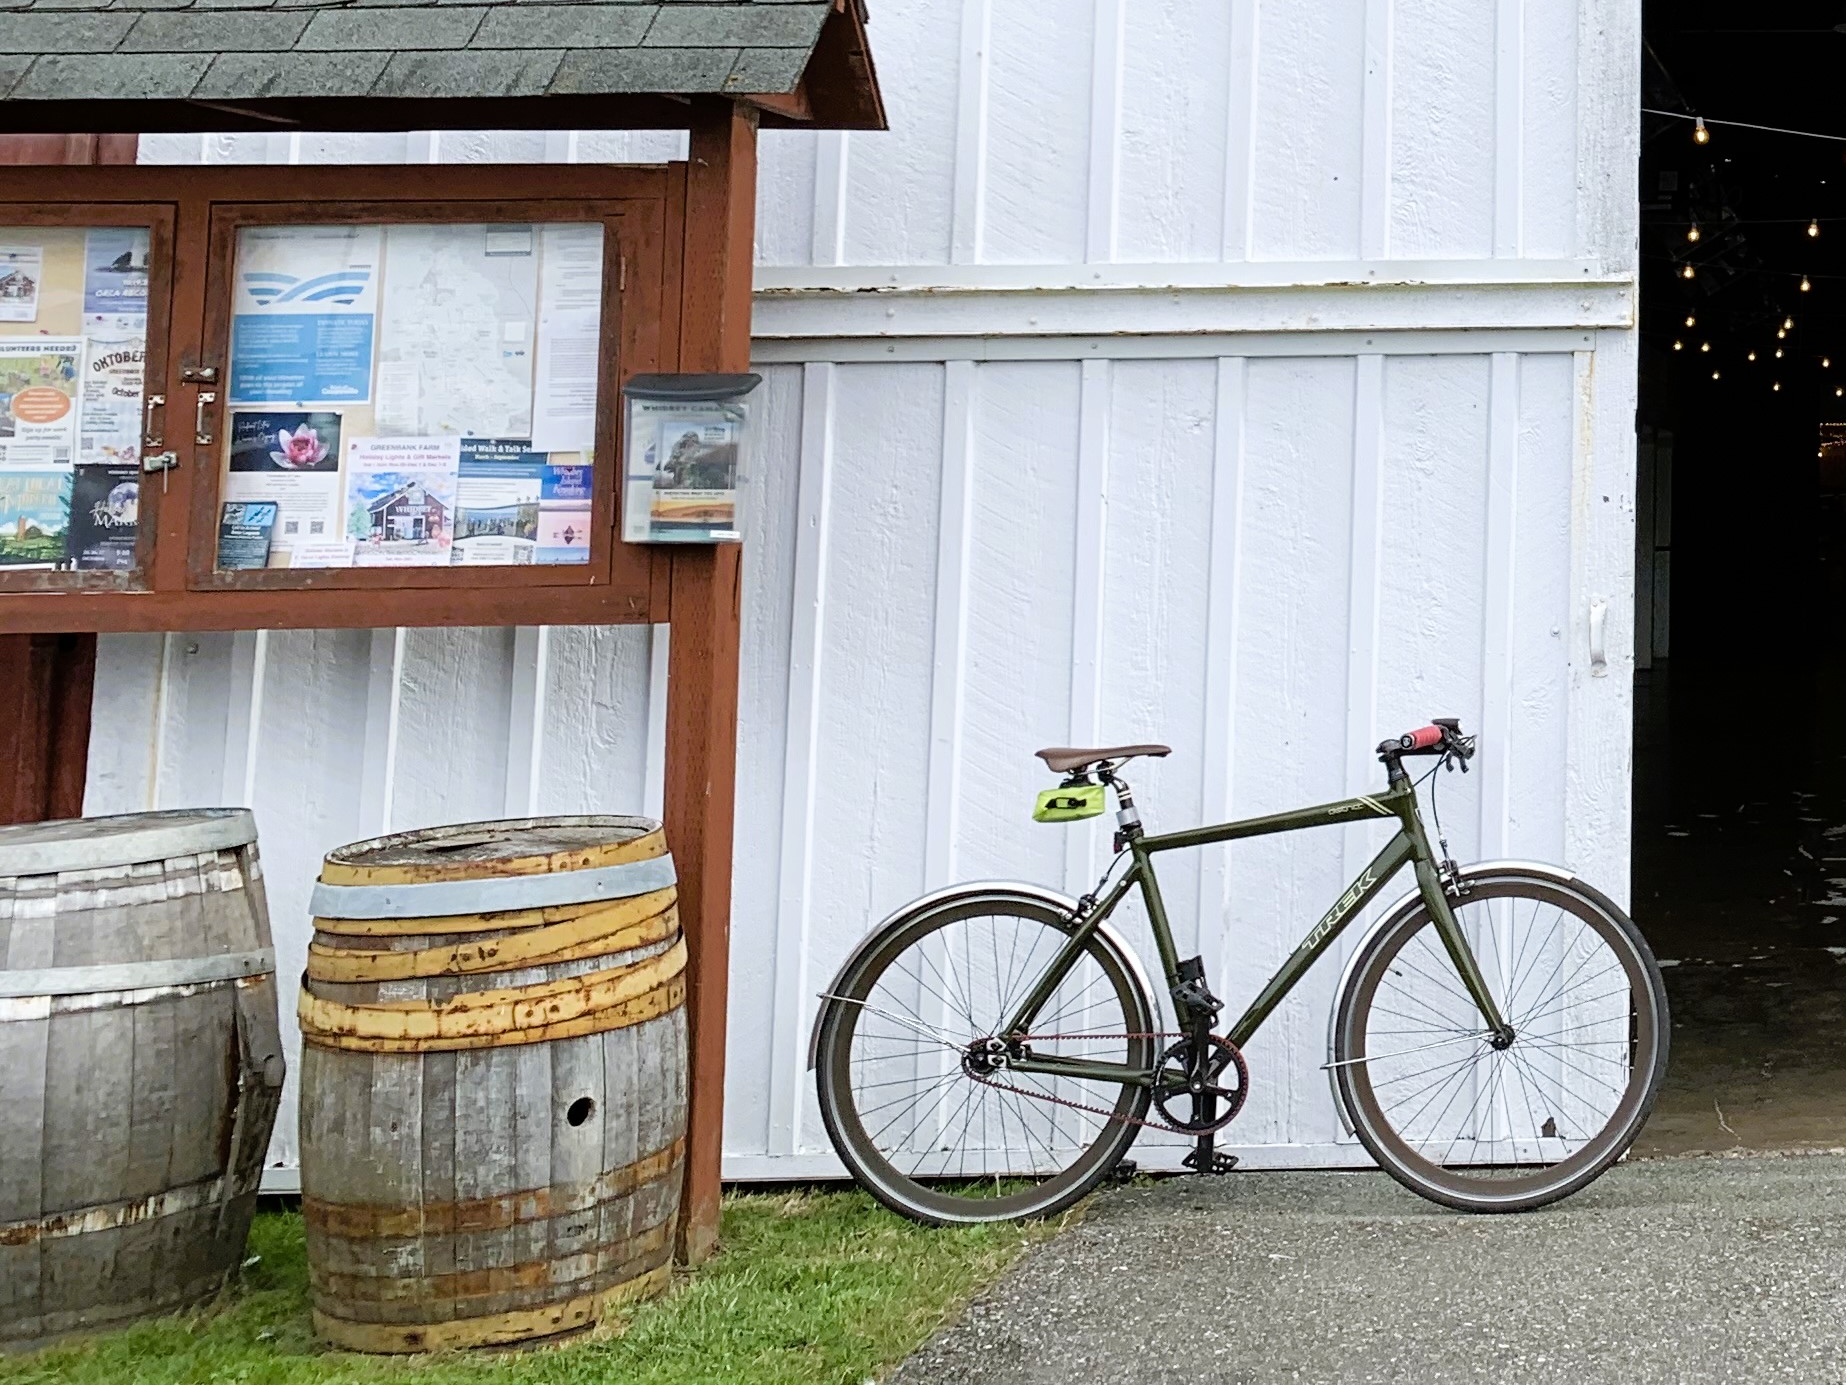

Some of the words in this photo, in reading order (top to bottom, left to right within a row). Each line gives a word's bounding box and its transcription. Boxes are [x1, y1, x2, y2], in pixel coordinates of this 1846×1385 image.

[478, 444, 497, 452] Walk
[498, 444, 504, 452] &
[505, 444, 521, 453] Talk
[1301, 866, 1377, 950] TREK
